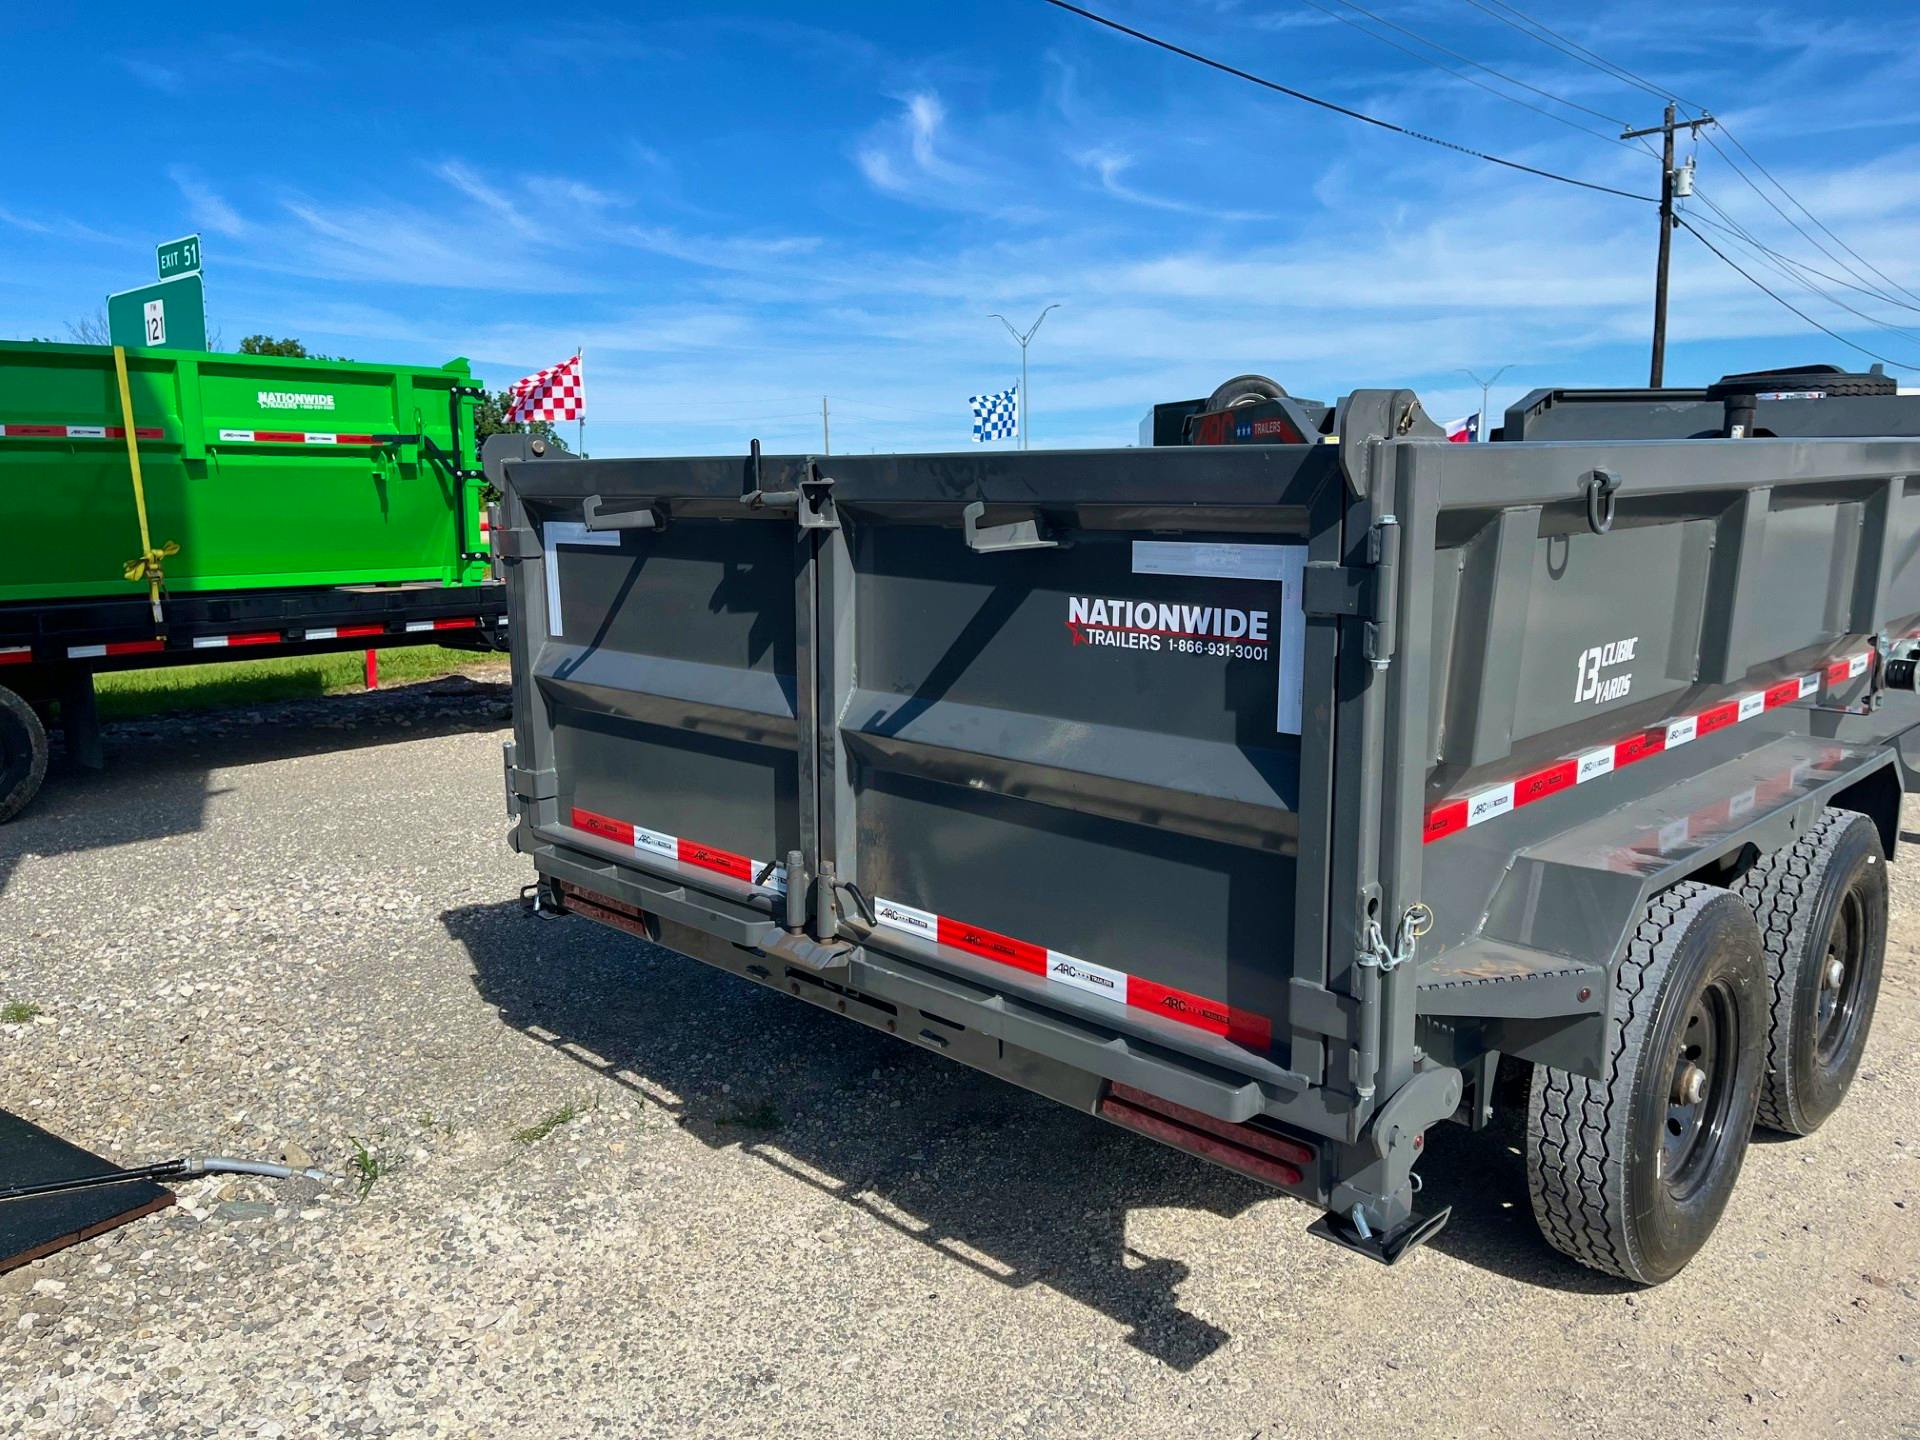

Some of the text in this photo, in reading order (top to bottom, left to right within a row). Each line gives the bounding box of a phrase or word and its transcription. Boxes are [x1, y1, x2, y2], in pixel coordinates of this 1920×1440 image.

[161, 243, 197, 269] EXIT 51
[146, 316, 164, 342] 121
[258, 391, 335, 406] NATIONWIDE
[1254, 421, 1281, 435] TRAILERS
[1068, 596, 1269, 641] NATIONWIDE
[1086, 628, 1268, 661] TRAILERS 1-866-931-3001
[1574, 636, 1639, 703] 13 CUBIC
[1595, 673, 1632, 704] YARDS
[1471, 802, 1488, 818] ARC
[879, 907, 899, 922] ARC
[1052, 962, 1114, 988] ARC TRAILERS
[1160, 996, 1187, 1012] ARC
